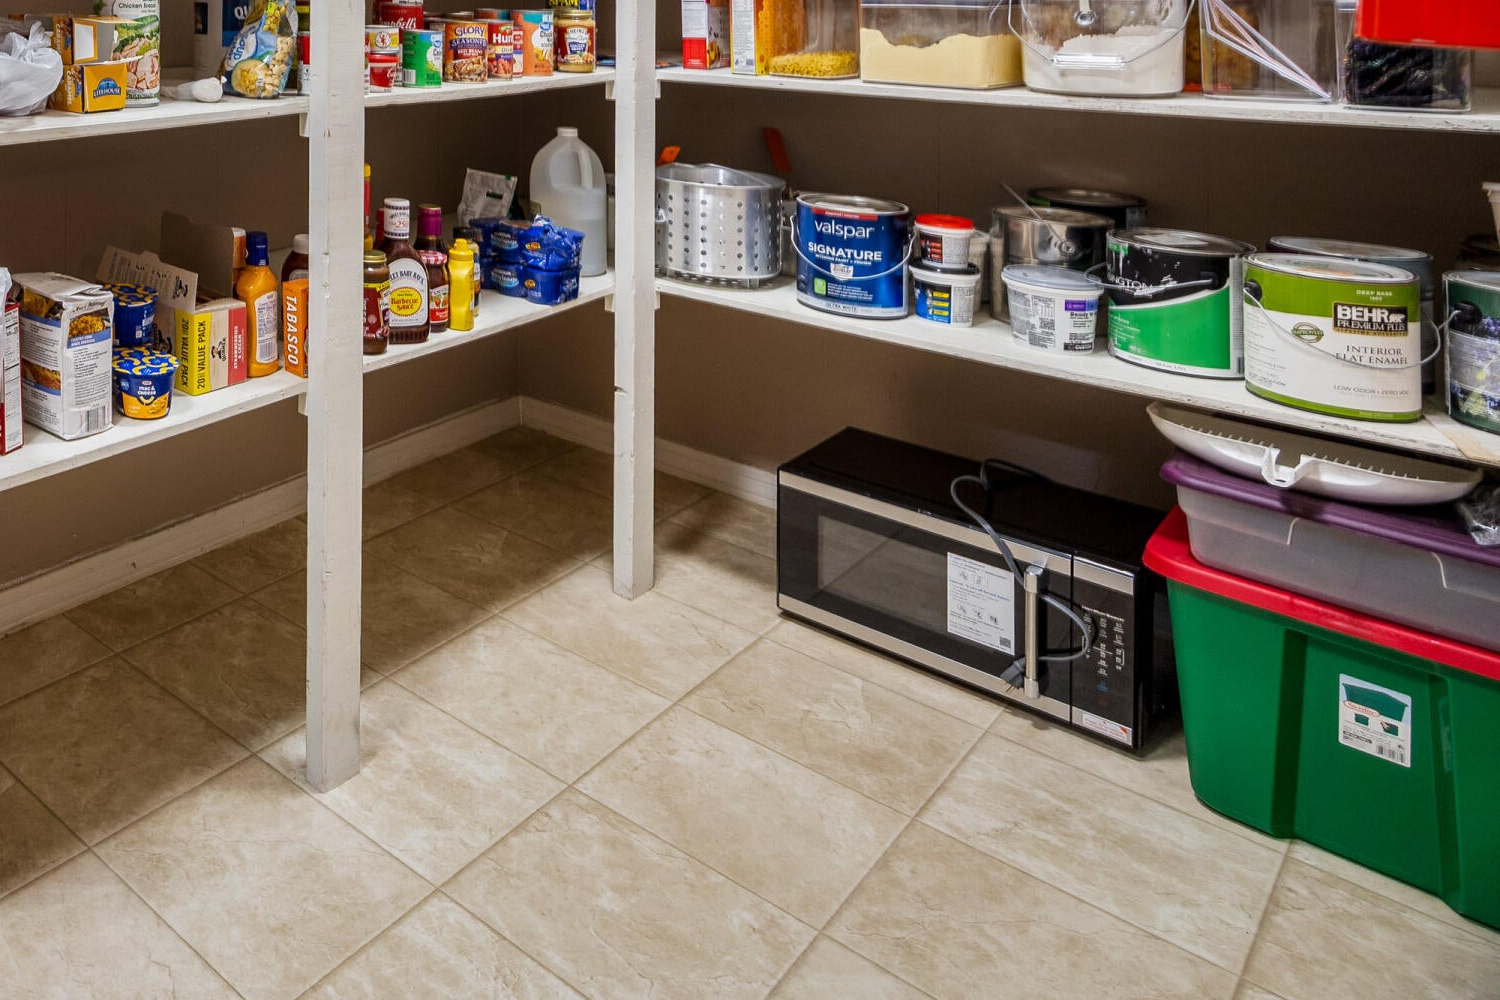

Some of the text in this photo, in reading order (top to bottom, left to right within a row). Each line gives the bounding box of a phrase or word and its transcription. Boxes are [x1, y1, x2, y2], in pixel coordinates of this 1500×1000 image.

[454, 26, 485, 38] GLORY
[814, 219, 875, 240] valspar
[808, 241, 883, 261] SIGNATURE
[1336, 304, 1389, 323] BEHR
[198, 320, 206, 345] PACK
[286, 295, 298, 366] TABASCO
[1337, 319, 1406, 331] PREMIUM PLUS
[182, 335, 190, 362] VALUE
[1346, 344, 1402, 356] INTERIOR
[197, 347, 206, 372] VALUE
[182, 364, 190, 388] PACK
